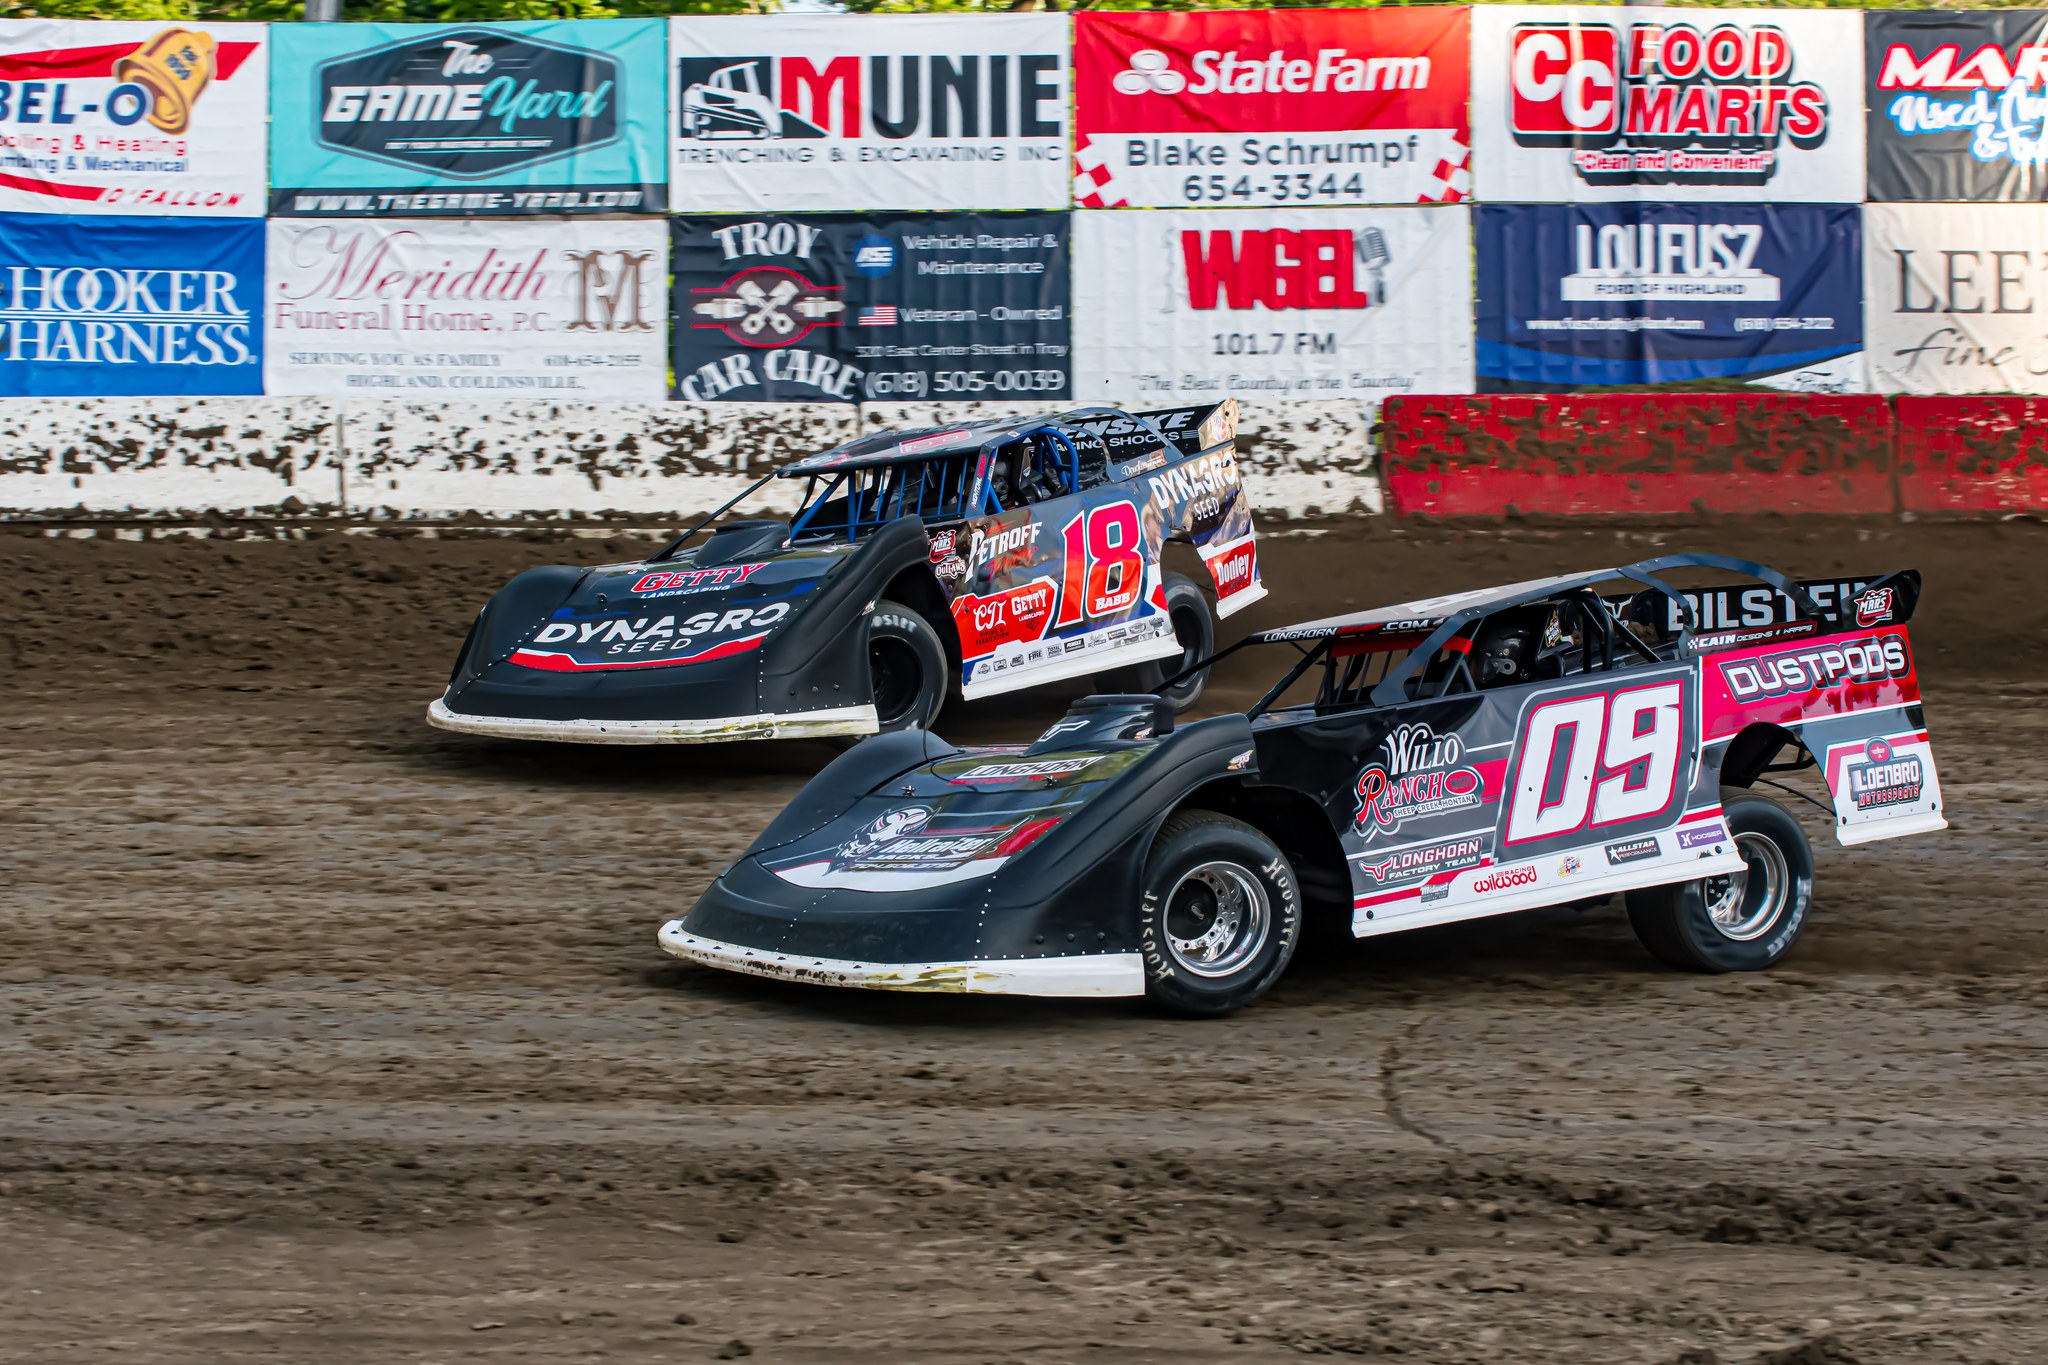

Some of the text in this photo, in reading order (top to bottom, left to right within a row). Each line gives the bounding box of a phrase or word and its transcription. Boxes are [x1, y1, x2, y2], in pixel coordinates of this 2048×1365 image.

[442, 40, 495, 78] The
[1625, 26, 1792, 80] FOOD
[323, 75, 614, 133] GAME Yard
[780, 55, 1060, 138] MUNIE
[1622, 84, 1826, 138] MARTS
[74, 134, 85, 150] &
[97, 134, 187, 157] Heating
[678, 146, 1063, 164] TRENCHING & EXCAVATING INC
[1127, 134, 1420, 168] Blake Schrumpf
[66, 156, 77, 170] &
[84, 156, 188, 172] Mechanical
[1636, 154, 1666, 169] and
[106, 188, 243, 207] O'FALLON
[1184, 172, 1364, 201] 654-3344
[712, 222, 822, 260] TROY
[902, 234, 1059, 252] Vehicle Repair &
[1576, 224, 1763, 277] LOU FUSZ
[280, 225, 548, 300] Meridith
[855, 247, 893, 267] ASE
[918, 260, 1045, 275] Maintenance
[1182, 228, 1368, 310] WGEL
[4, 266, 250, 316] HOOKER
[1594, 283, 1747, 295] FORD OF HIGHLAND
[1893, 249, 2048, 313] LEE
[274, 303, 390, 331] Funeral
[899, 308, 977, 322] Veteran
[990, 305, 1062, 321] Owned
[4, 320, 250, 366] HARNESS
[1034, 343, 1069, 357] Troy
[1213, 333, 1336, 355] 101.7 FM
[1893, 327, 2018, 374] fine
[288, 352, 367, 366] SERVING
[413, 354, 432, 366] AS
[436, 353, 502, 366] FAMILY
[681, 349, 865, 400] CAR CARE
[865, 370, 1066, 398] (618) 505-0039
[1050, 411, 1195, 441] ENSKE
[1109, 431, 1181, 447] SHOCS
[1194, 497, 1221, 521] SEED
[965, 522, 1043, 584] PETROFF
[1054, 500, 1144, 629] 18
[631, 562, 772, 593] GETTY
[1214, 553, 1250, 587] Donley
[640, 584, 734, 600] LANDSCAPING
[1011, 589, 1047, 616] GETTY
[1095, 592, 1131, 611] BABB
[1860, 596, 1887, 615] MARS
[1667, 582, 1868, 632] BILSTE
[533, 602, 790, 644] DYNAGRO
[1263, 627, 1338, 643] LONGHORN
[1699, 634, 1736, 648] CAIN
[1737, 631, 1773, 642] DESIGNS
[1783, 624, 1814, 636] WRAPS
[607, 638, 692, 655] SEED
[1726, 641, 1906, 697] DUSTPODS
[957, 755, 1107, 779] LONGHORN
[1505, 682, 1683, 846] 09
[1853, 760, 1920, 792] LOENBRO
[1394, 807, 1416, 817] SHEEP
[1441, 795, 1478, 808] MONTANA
[1858, 784, 1919, 806] MOTORSPORTS
[1616, 840, 1655, 853] ALLSTAR
[1691, 830, 1722, 841] HOOSIER
[1389, 856, 1477, 880] FACTORY TEAM
[1392, 840, 1480, 870] LONGHORN
[1473, 865, 1538, 893] wilwood
[1504, 865, 1532, 876] RACING
